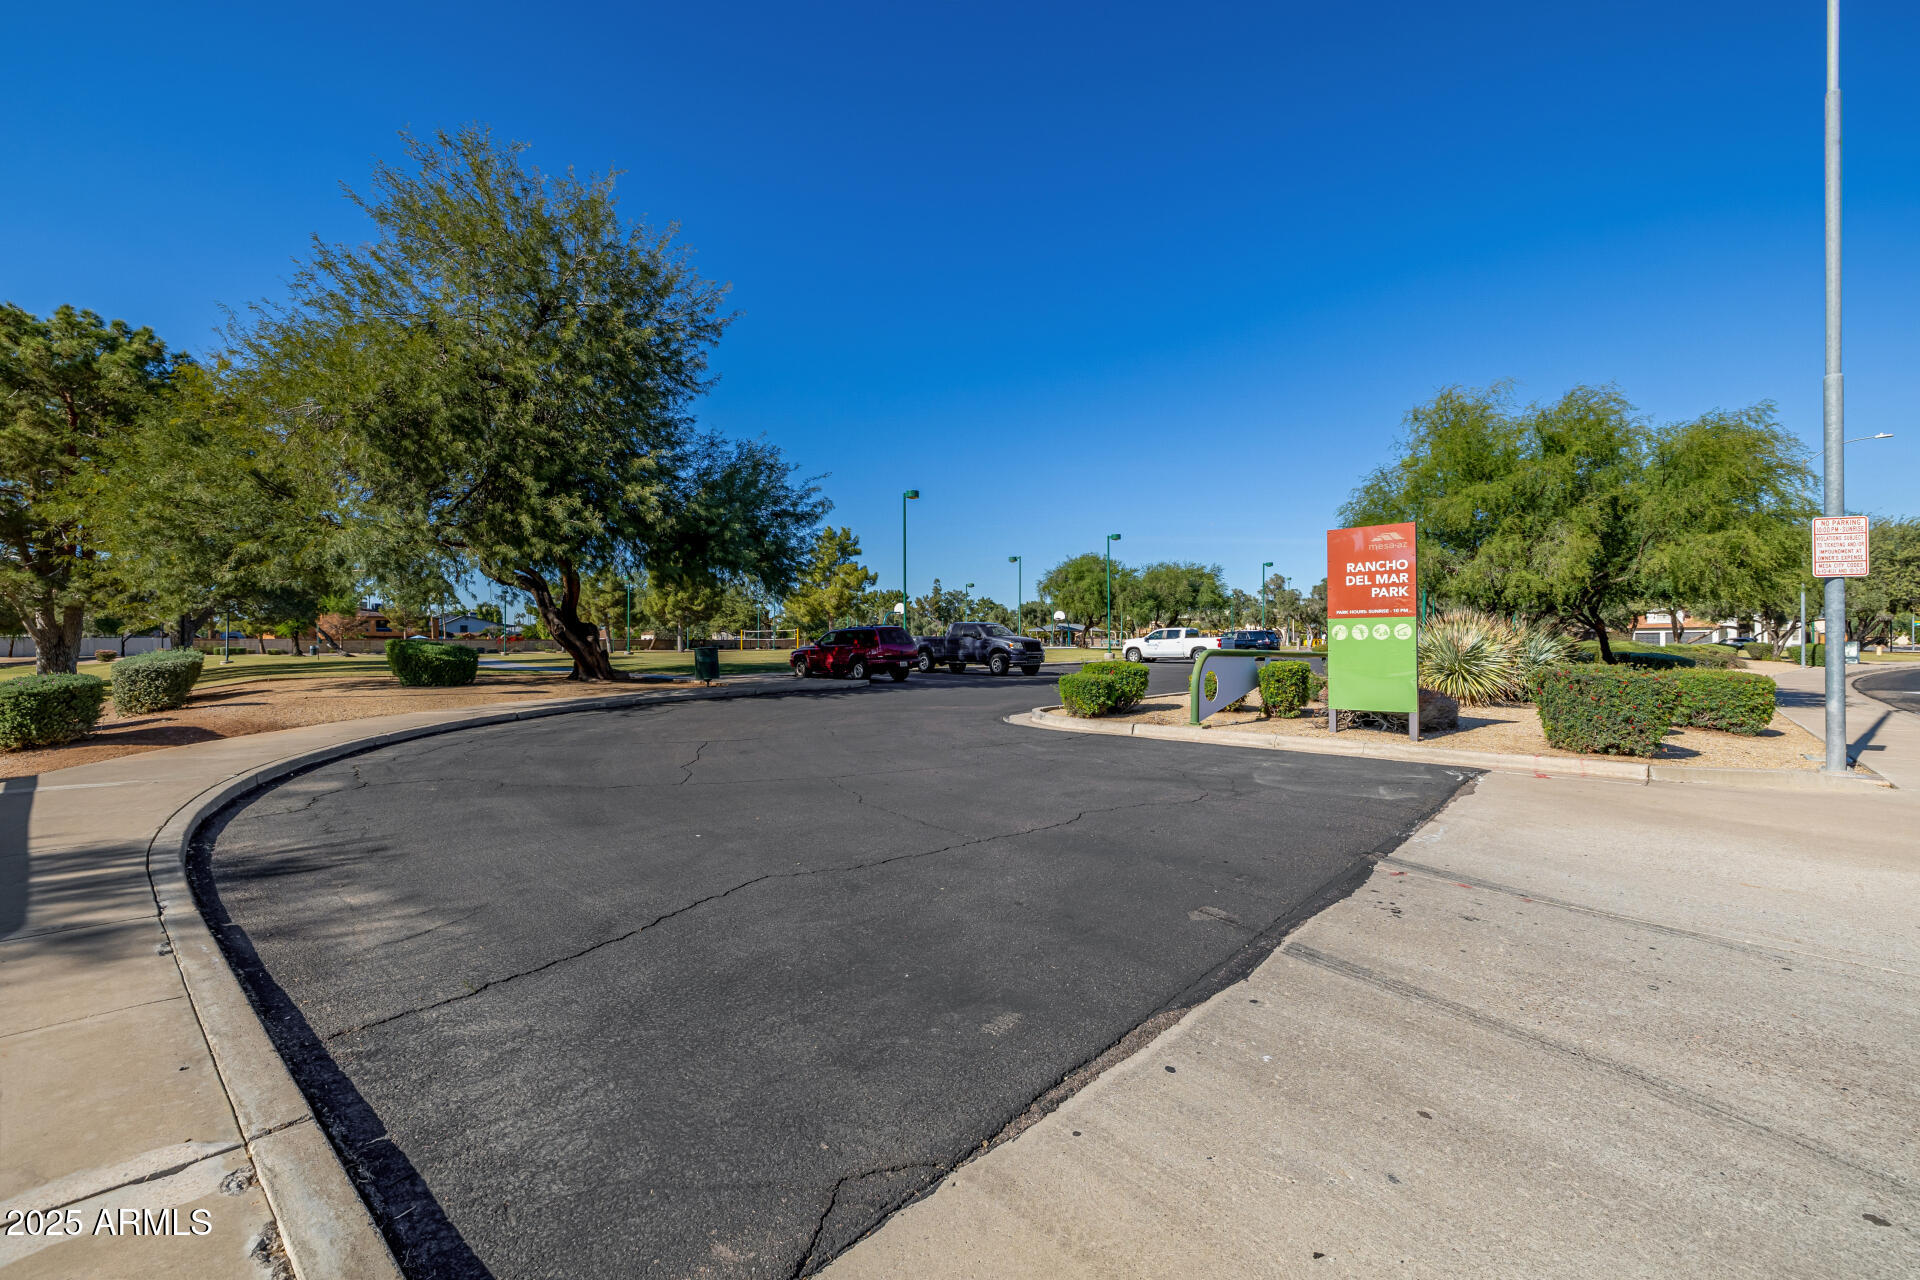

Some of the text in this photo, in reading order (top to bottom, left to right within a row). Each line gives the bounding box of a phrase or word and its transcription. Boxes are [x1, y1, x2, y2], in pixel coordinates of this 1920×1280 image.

[1346, 559, 1408, 573] RANCHO
[1346, 573, 1408, 586] DEL MAR
[1372, 586, 1408, 597] PARK
